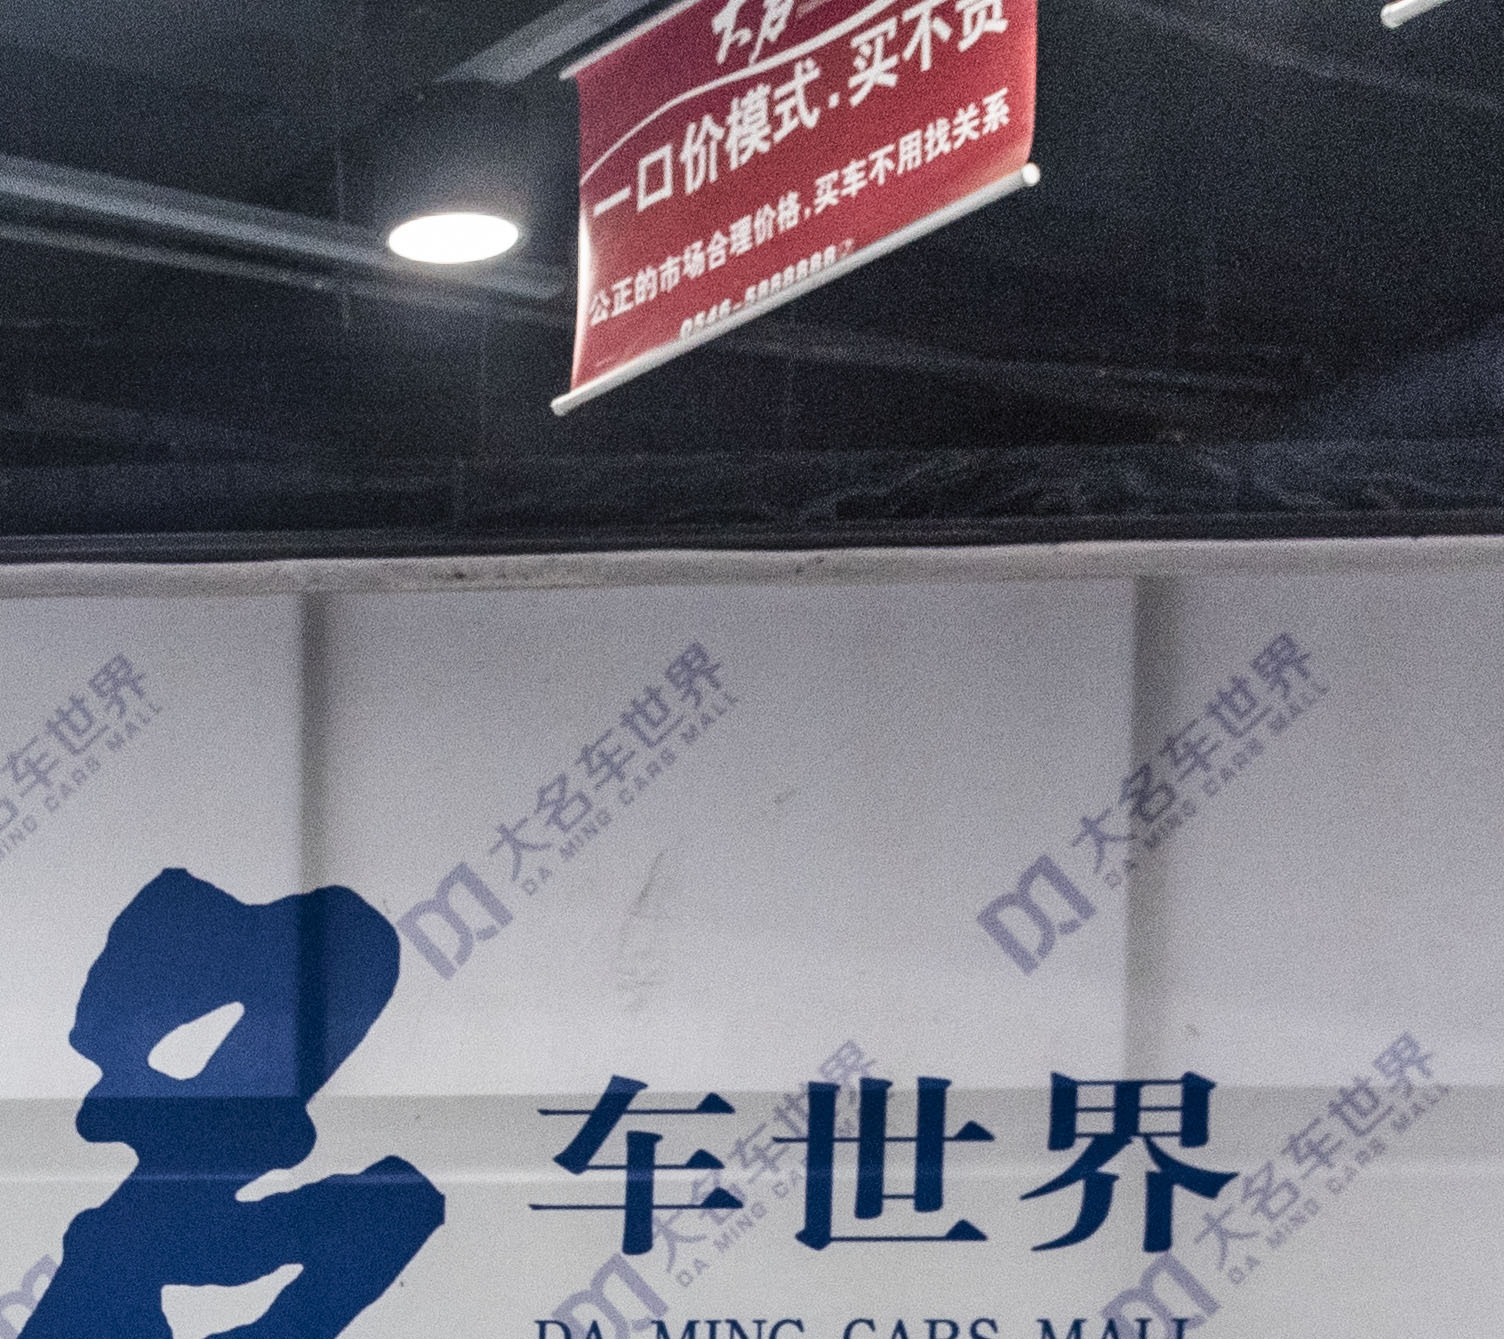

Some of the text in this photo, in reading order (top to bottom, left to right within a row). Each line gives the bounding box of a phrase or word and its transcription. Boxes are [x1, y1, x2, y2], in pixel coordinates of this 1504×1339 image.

[489, 642, 723, 883] 大名车世界
[1070, 632, 1313, 875] 大名车世界
[529, 1071, 1240, 1255] 车世界
[1192, 1030, 1433, 1268] 大名车世界
